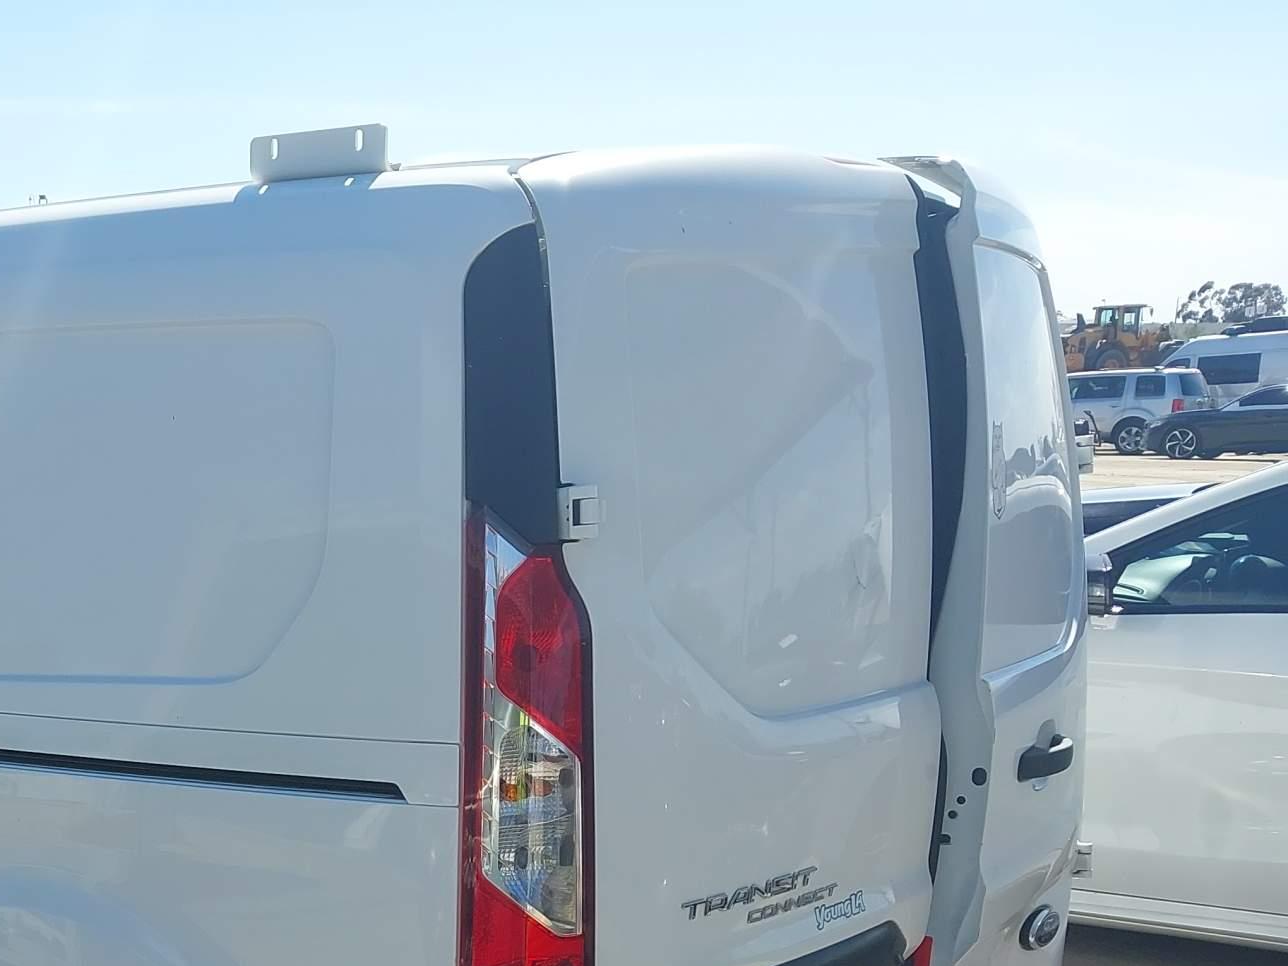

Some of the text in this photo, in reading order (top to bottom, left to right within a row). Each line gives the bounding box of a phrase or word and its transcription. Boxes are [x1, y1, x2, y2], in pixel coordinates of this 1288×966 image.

[681, 866, 818, 920] TRANSIT
[747, 882, 838, 924] CONNECT
[814, 889, 866, 931] YoungLA
